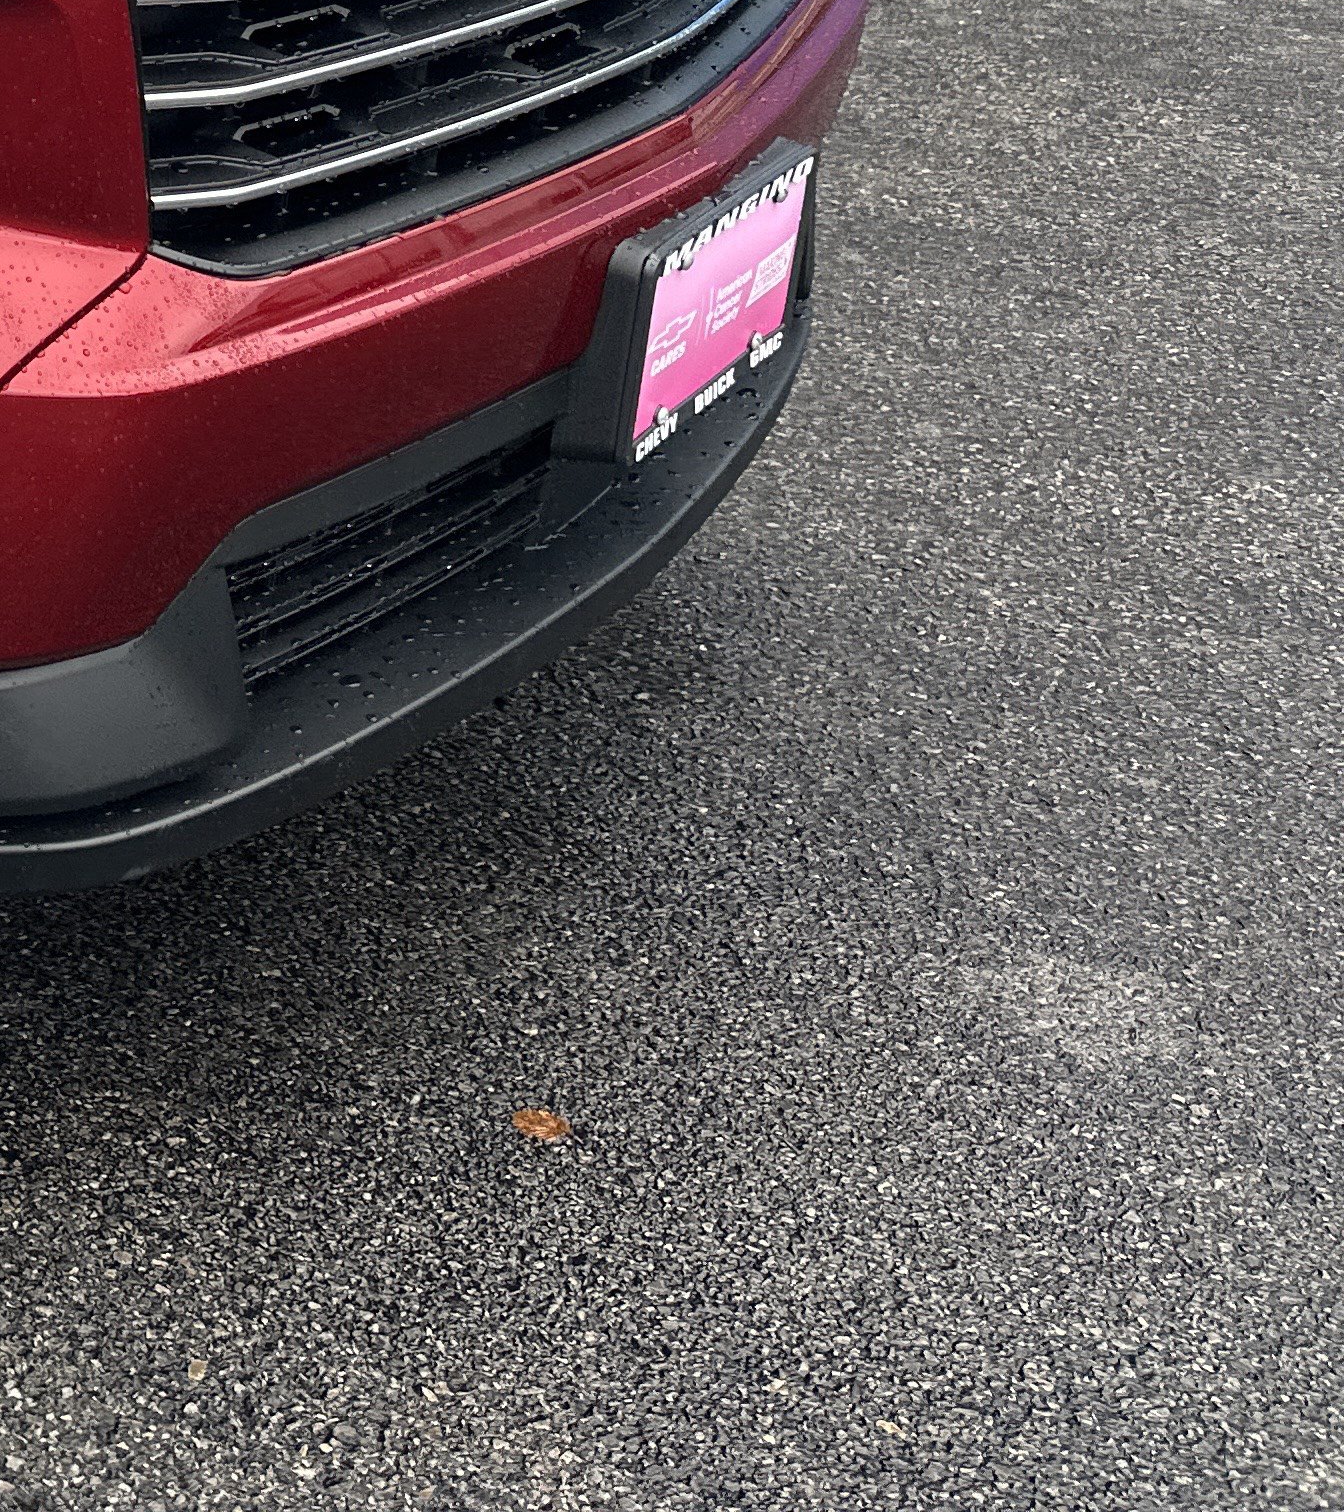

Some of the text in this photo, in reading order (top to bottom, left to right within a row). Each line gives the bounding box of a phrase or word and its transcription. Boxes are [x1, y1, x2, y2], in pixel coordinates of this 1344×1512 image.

[662, 156, 815, 277] MANGINO
[635, 331, 784, 463] CHEVY BUICK GMC
